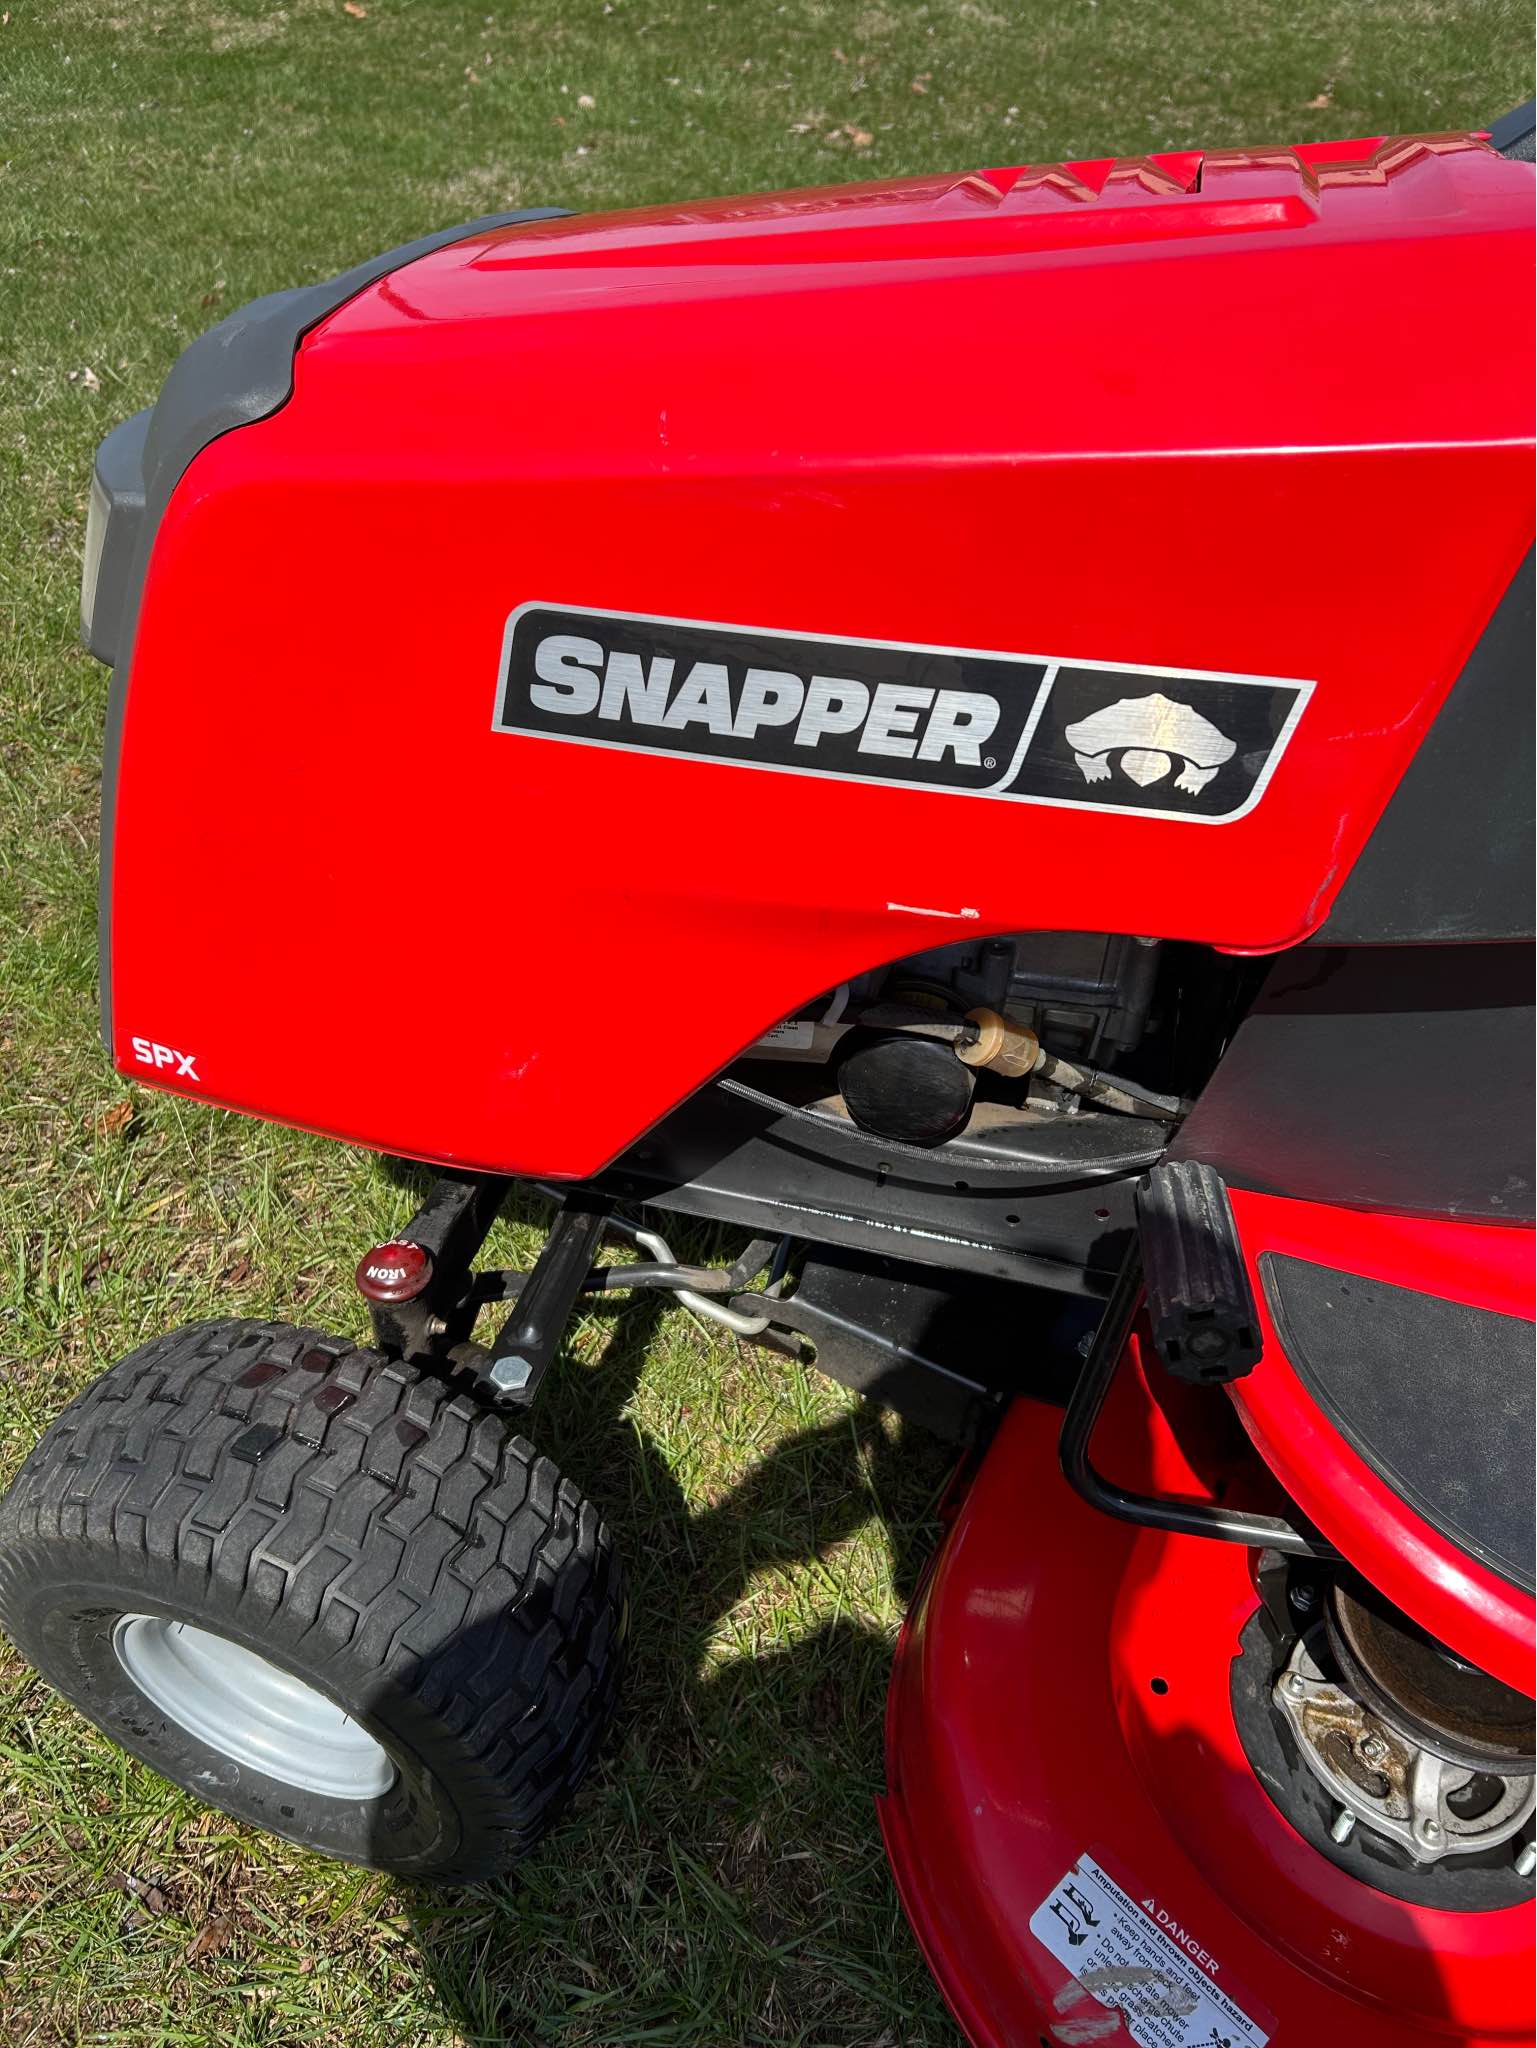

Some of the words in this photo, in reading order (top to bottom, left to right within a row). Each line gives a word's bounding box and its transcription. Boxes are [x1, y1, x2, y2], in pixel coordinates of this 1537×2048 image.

[530, 636, 1000, 766] SNAPPER
[132, 1036, 201, 1082] SPX
[366, 1266, 407, 1281] IRON
[1079, 1965, 1088, 1977] is
[1091, 1869, 1139, 1918] Amputation
[1139, 1918, 1158, 1936] and
[1156, 1934, 1188, 1967] thrown
[1188, 1967, 1221, 2000] objects
[1220, 1998, 1254, 2032] hazard
[1111, 1927, 1134, 1950] away
[1133, 1948, 1153, 1971] from
[1118, 1916, 1140, 1941] Keep
[1140, 1939, 1166, 1968] hands
[1166, 1967, 1184, 1985] and
[1182, 1982, 1201, 2002] feet
[1156, 1910, 1220, 1975] DANGER
[1087, 1958, 1098, 1968] or
[1119, 1992, 1144, 2017] grass
[1143, 2016, 1175, 2048] catcher
[1101, 1937, 1115, 1954] Do
[1114, 1952, 1130, 1968] not
[1160, 1999, 1190, 2029] mower
[1160, 2017, 1185, 2043] chute
